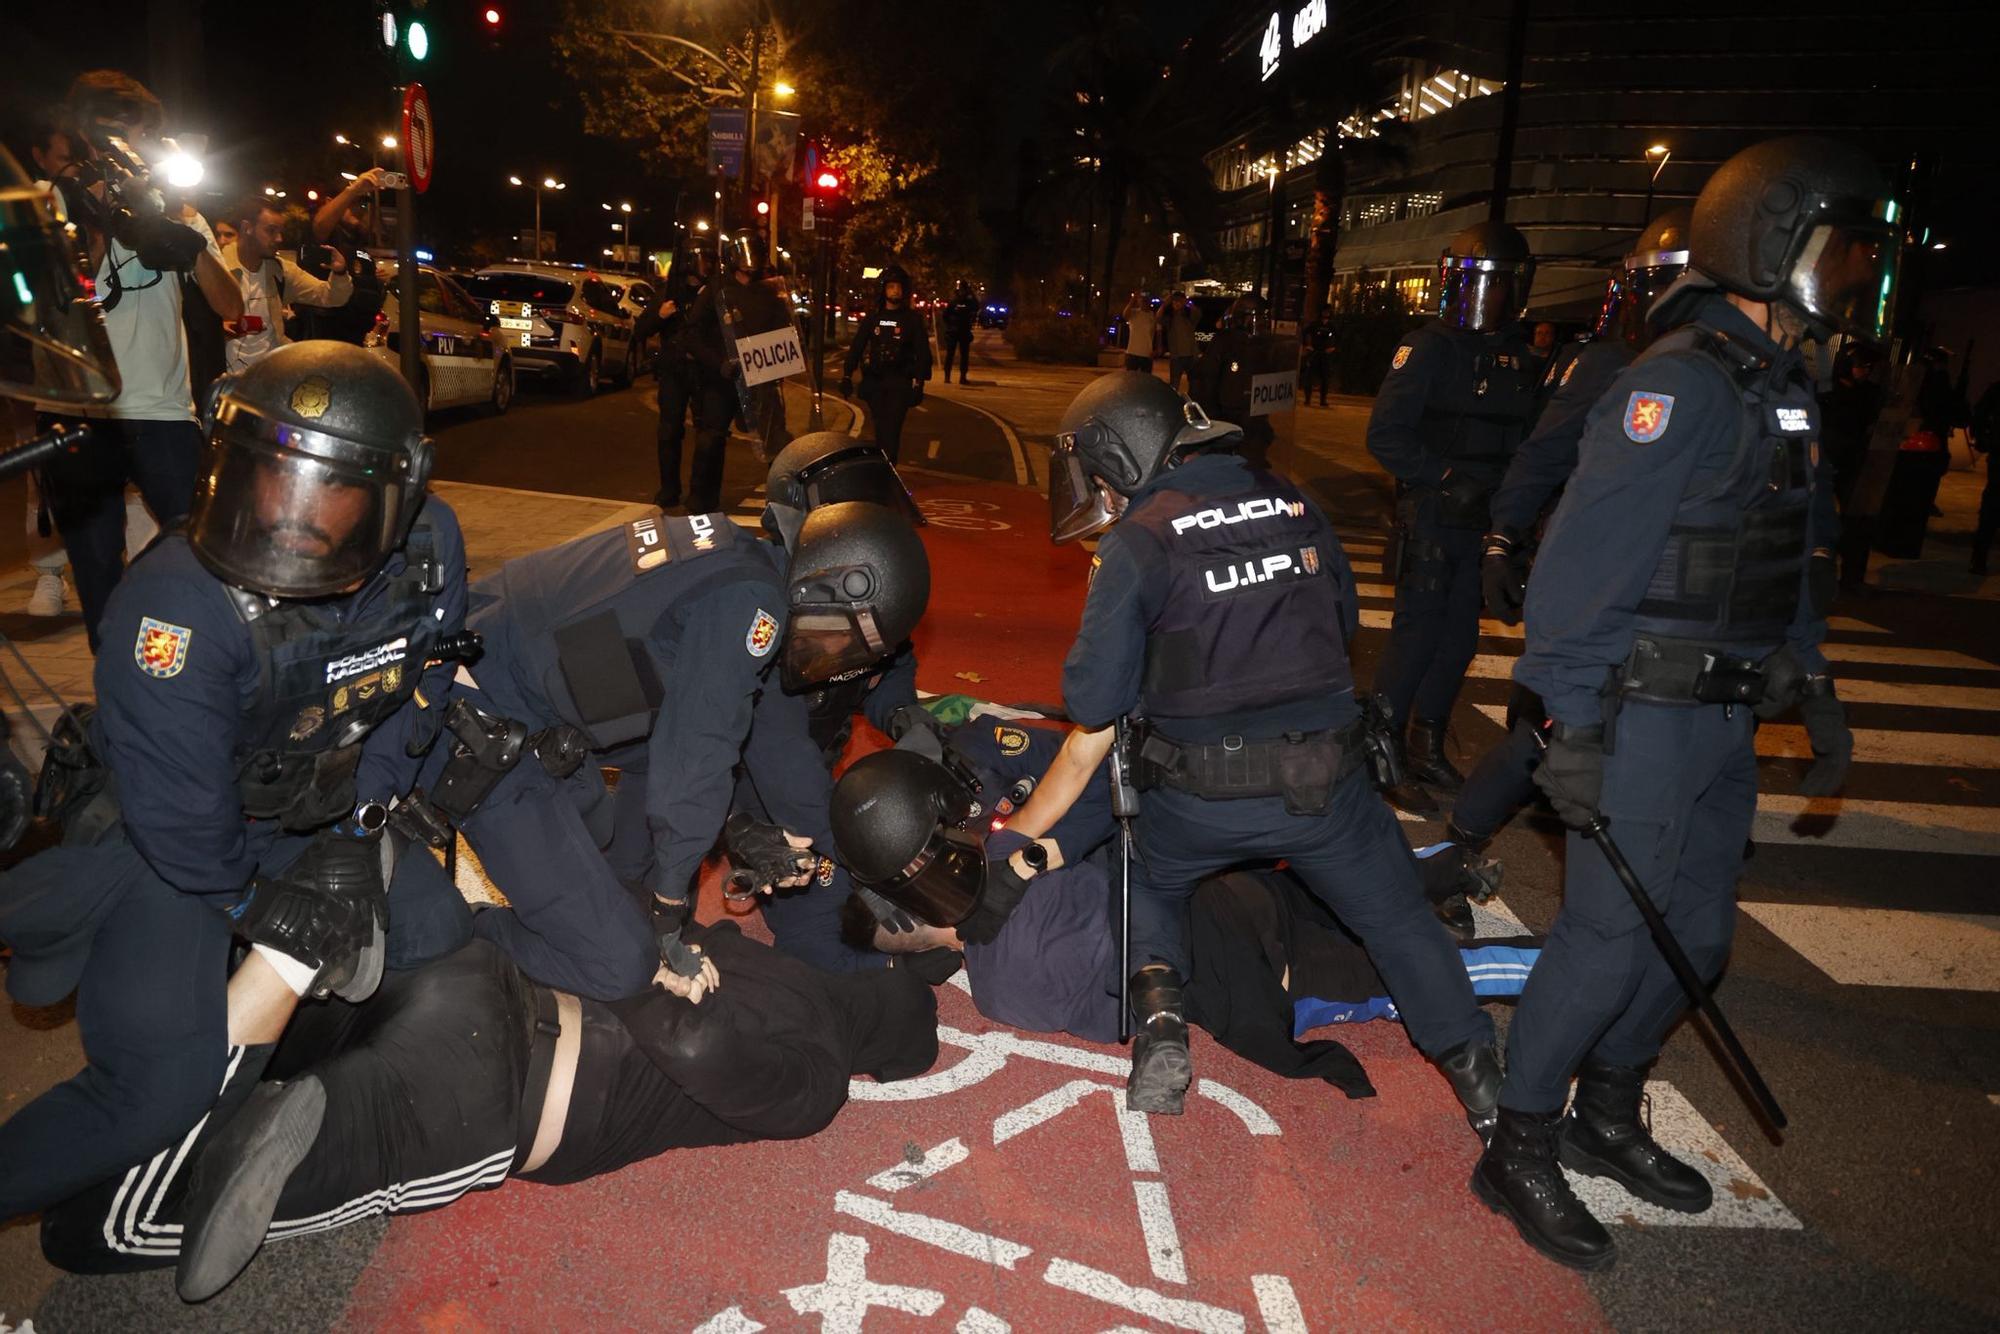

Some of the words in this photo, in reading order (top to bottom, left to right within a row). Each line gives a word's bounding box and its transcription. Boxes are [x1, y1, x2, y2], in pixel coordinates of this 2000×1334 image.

[438, 337, 454, 354] PLV
[1205, 554, 1301, 593] U.I.P.
[326, 651, 406, 684] NACIONAL
